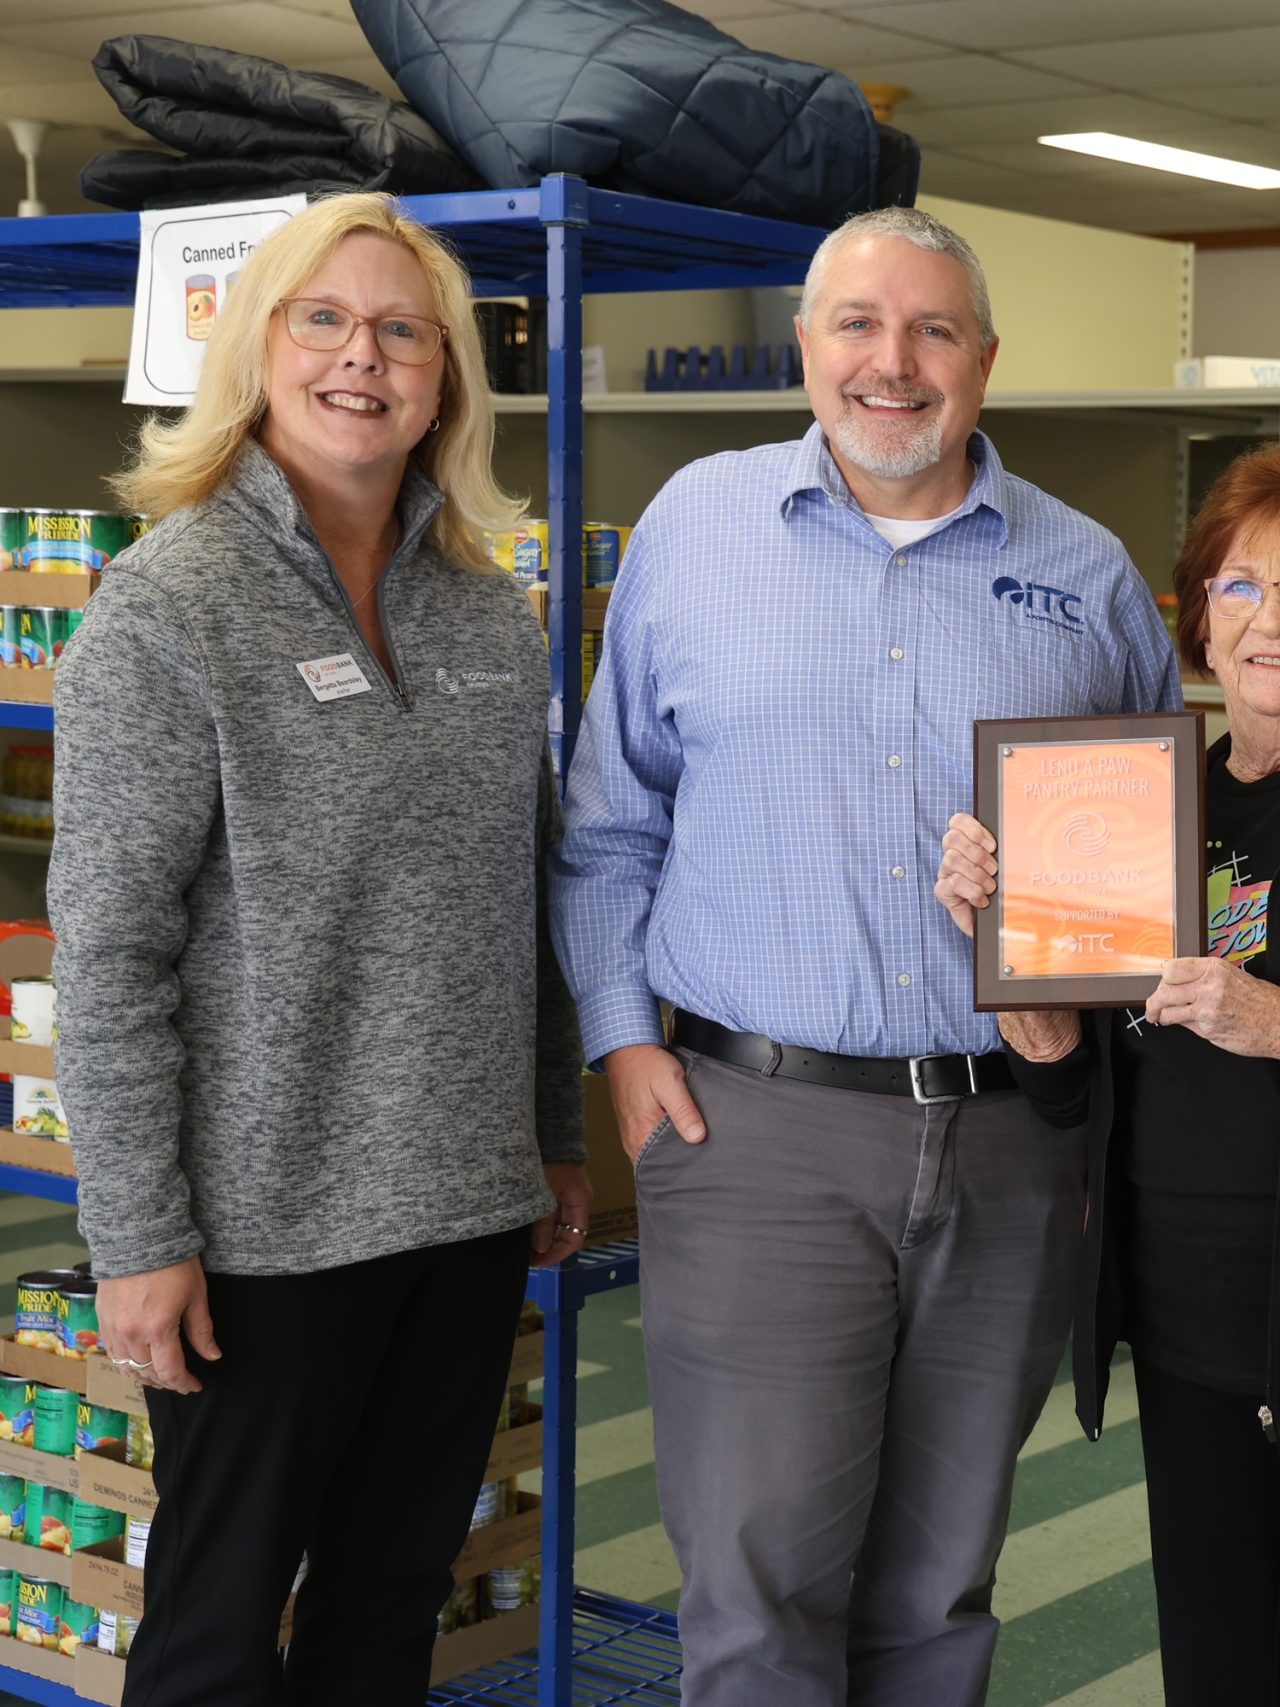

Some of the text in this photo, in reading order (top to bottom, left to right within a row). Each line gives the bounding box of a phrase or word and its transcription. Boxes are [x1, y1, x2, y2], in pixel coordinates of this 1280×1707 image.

[182, 241, 256, 263] Canned Fr
[320, 659, 353, 671] FOODBANK
[1041, 756, 1133, 777] LEND A PAW
[1024, 778, 1150, 801] PANTRY PARTNER
[1030, 868, 1146, 887] FOODBANK
[1055, 907, 1120, 921] SUPPORTED BY
[18, 1287, 60, 1307] MISSION
[123, 1579, 144, 1593] CANN
